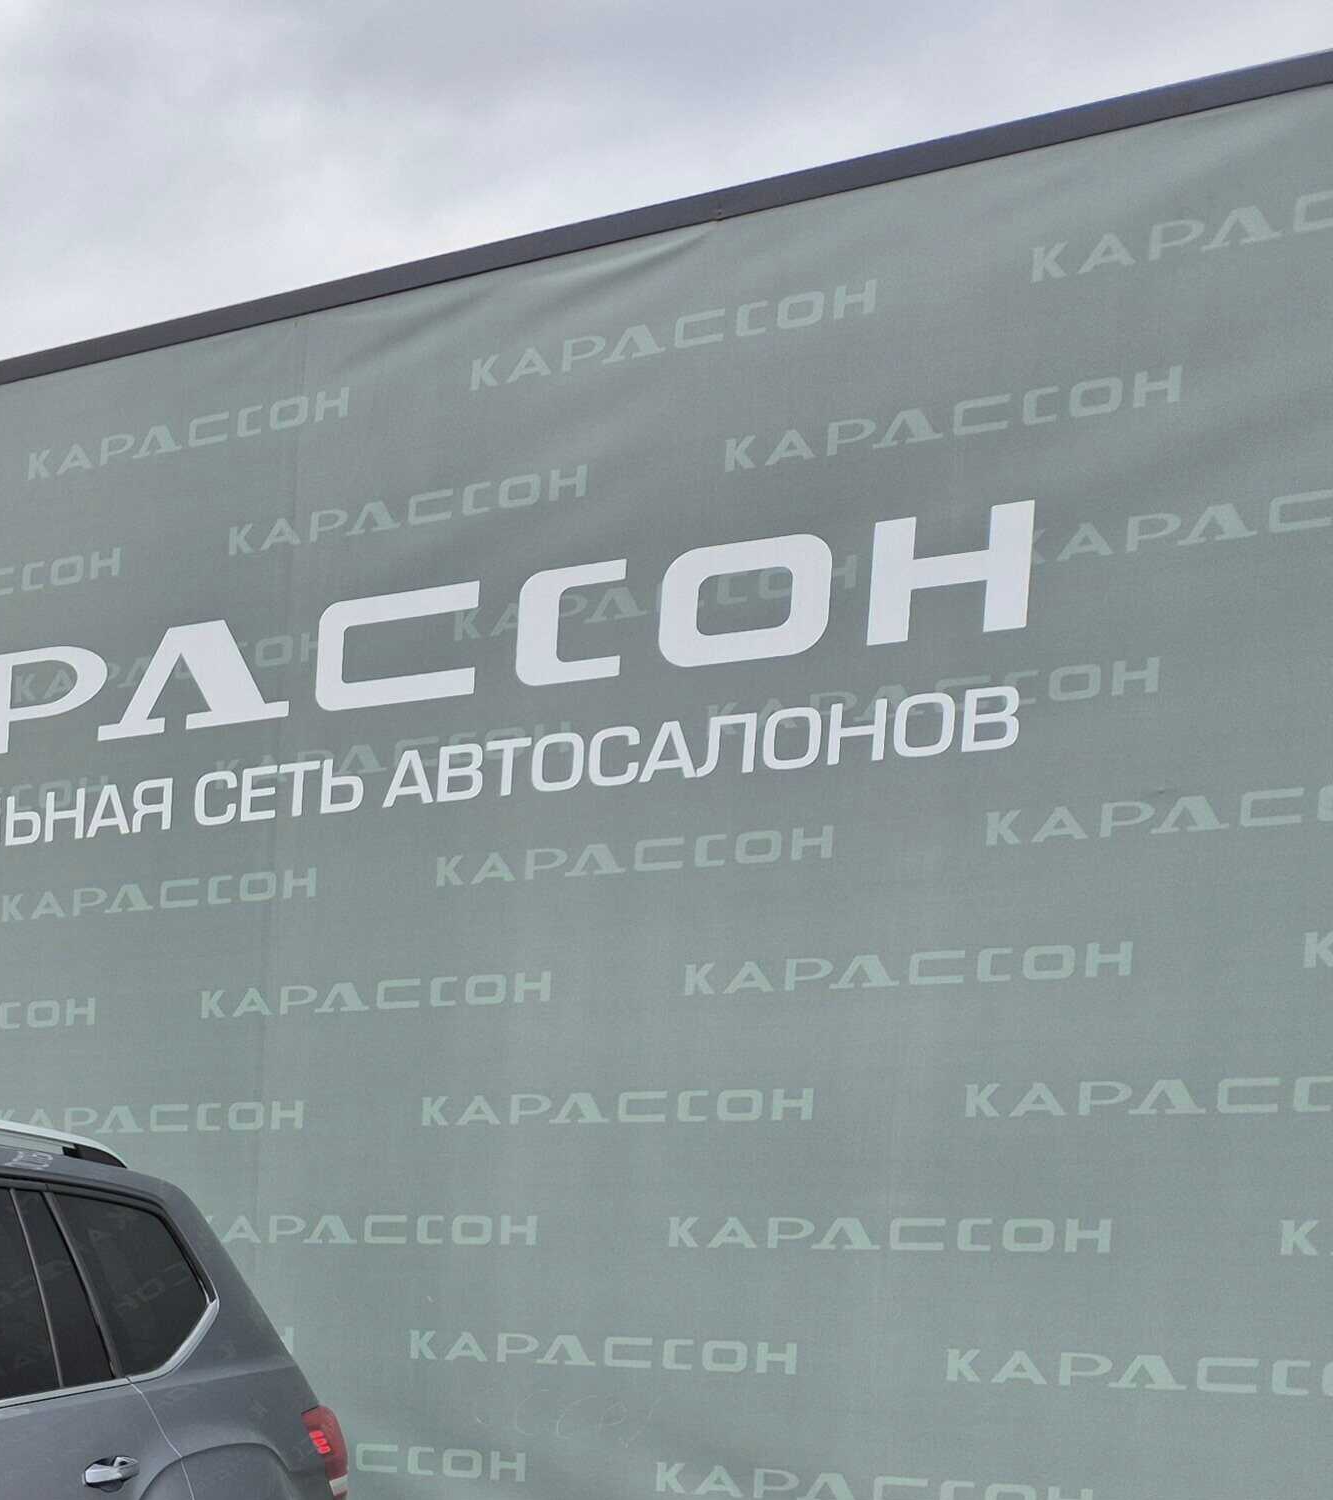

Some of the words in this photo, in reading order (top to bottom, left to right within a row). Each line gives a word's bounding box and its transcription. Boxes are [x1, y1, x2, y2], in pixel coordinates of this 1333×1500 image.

[1030, 190, 1333, 284] КАРАС
[192, 759, 365, 827] СЕТЬ
[381, 685, 1021, 808] АВТОСАЛОНОВ
[985, 784, 1333, 848] КАРАС
[964, 1075, 1333, 1119] КАРАСС
[944, 1347, 1333, 1397] КАРАСС
